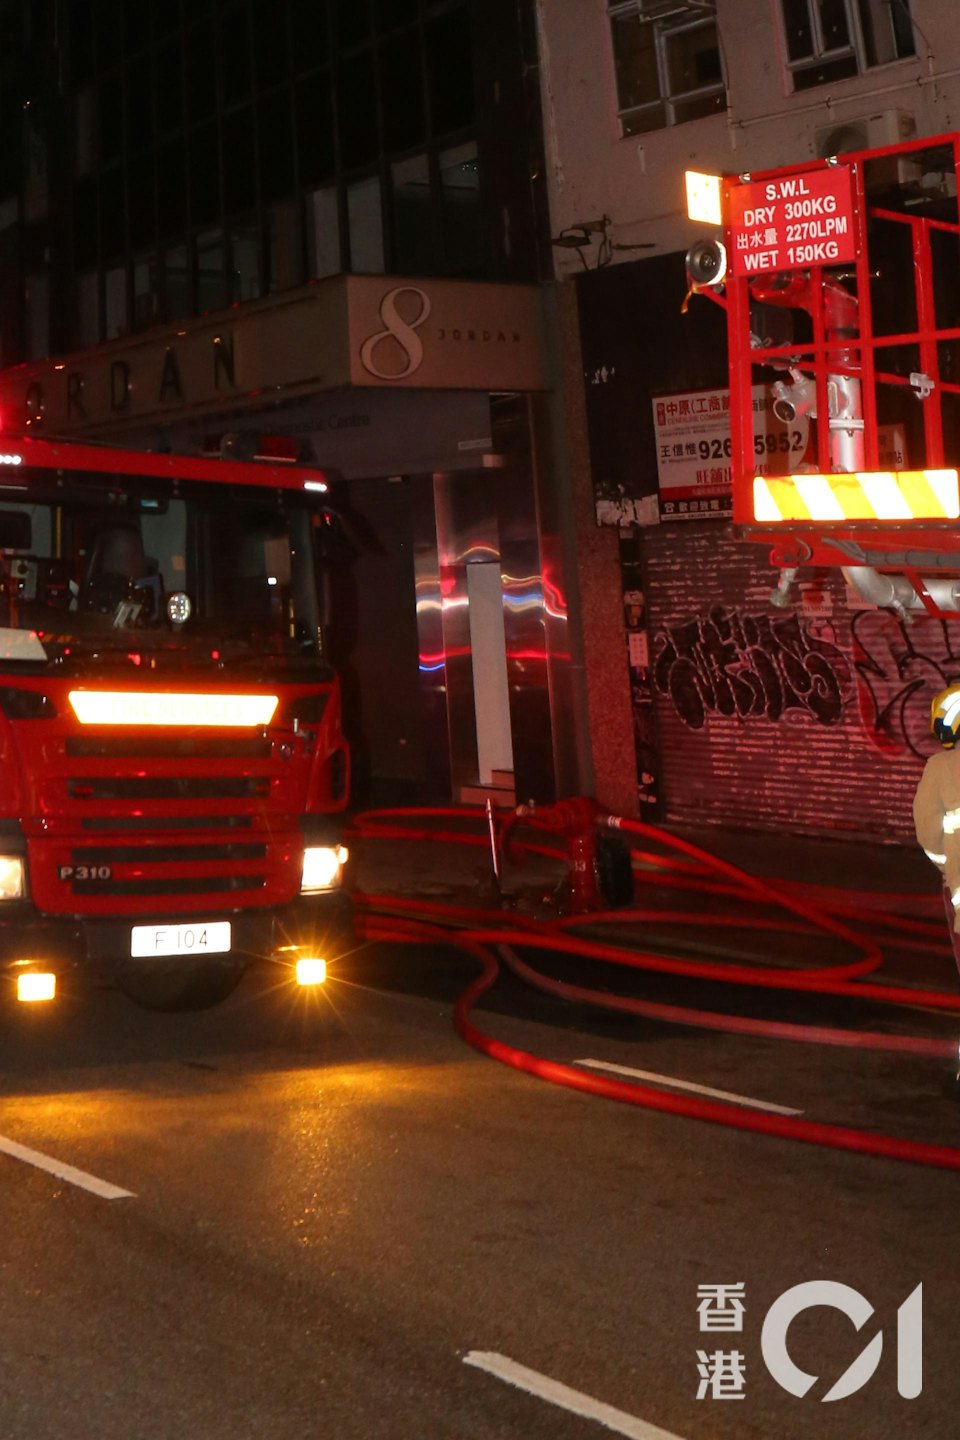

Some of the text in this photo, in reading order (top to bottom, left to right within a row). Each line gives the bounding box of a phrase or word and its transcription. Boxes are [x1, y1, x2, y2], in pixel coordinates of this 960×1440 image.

[766, 179, 810, 201] S.W.L
[744, 195, 837, 227] DRY 300KG
[736, 216, 848, 250] 出水量 2270LPM
[744, 241, 839, 271] WET 150KG
[360, 286, 521, 380] 8 JORDAN
[24, 332, 236, 424] ORDAN
[699, 438, 732, 460] 926
[154, 931, 167, 950] F
